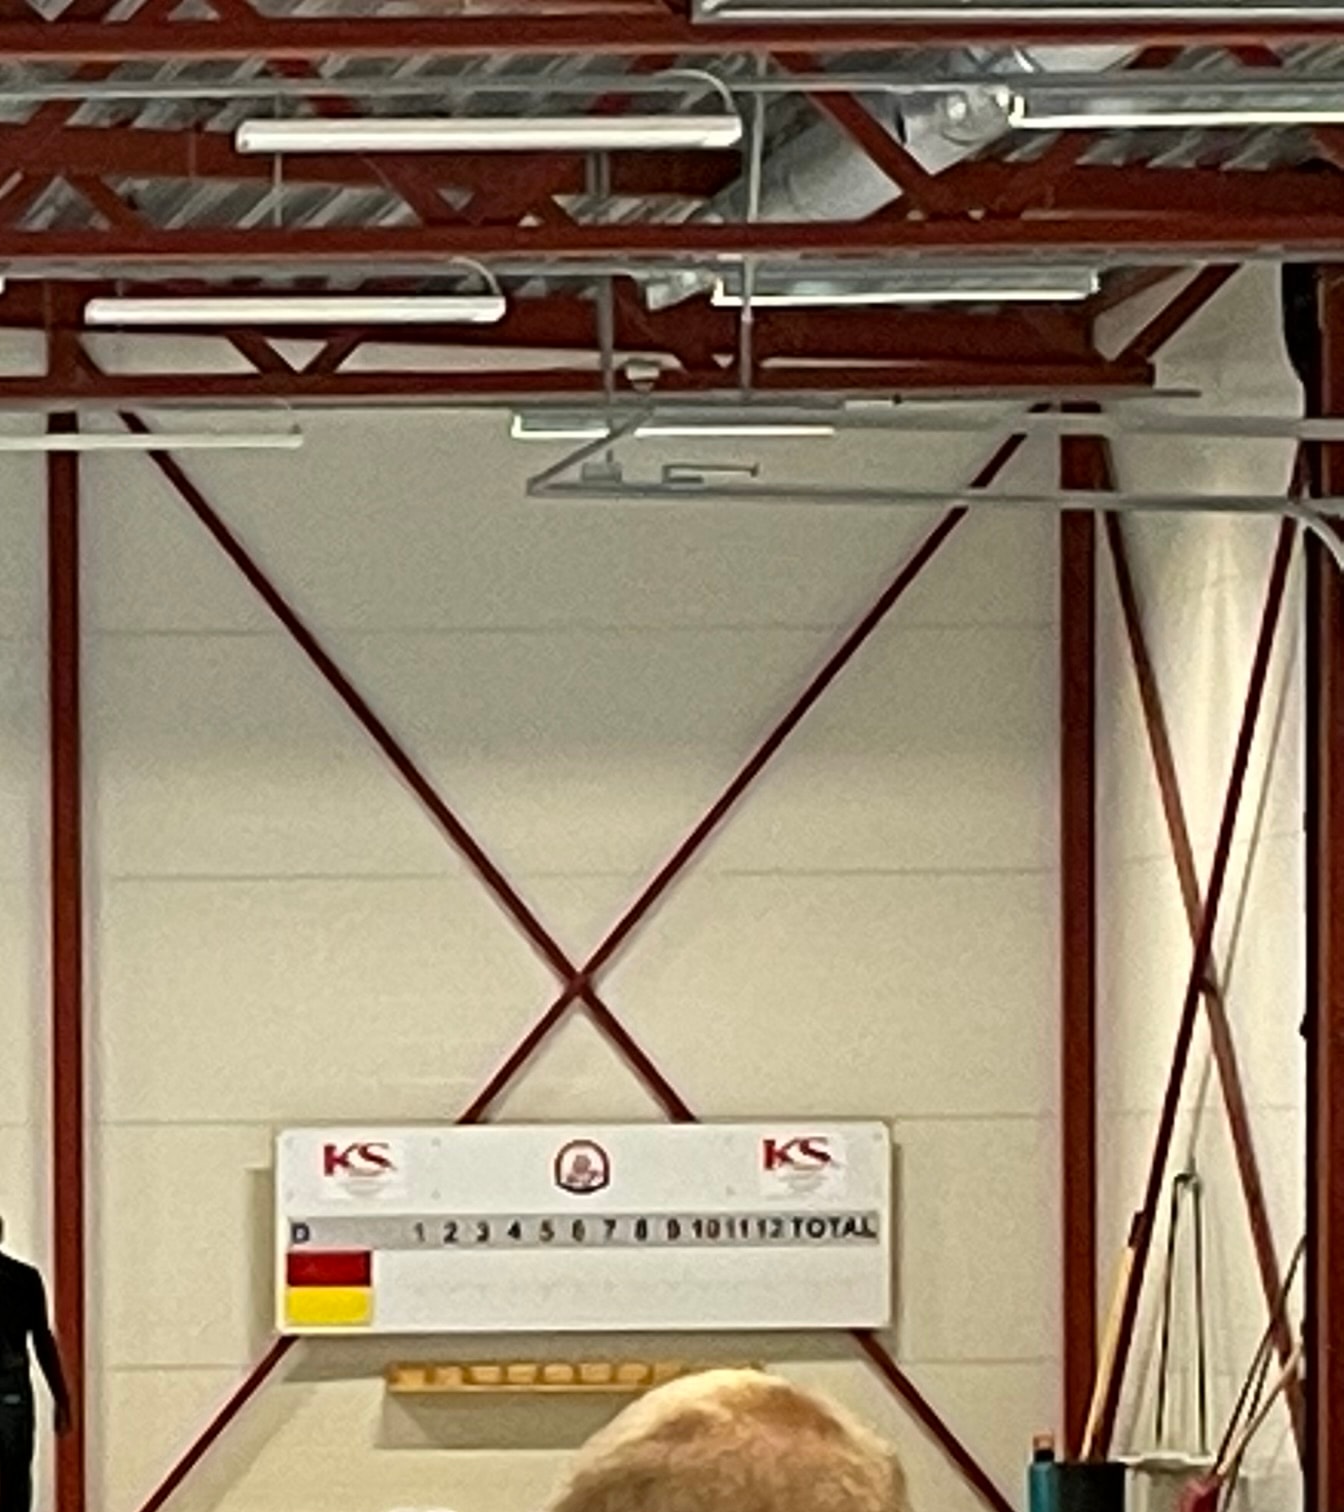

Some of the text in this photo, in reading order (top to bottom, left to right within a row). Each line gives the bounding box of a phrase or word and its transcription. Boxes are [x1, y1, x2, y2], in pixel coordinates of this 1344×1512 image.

[323, 1142, 393, 1177] KS
[763, 1136, 833, 1171] KS
[291, 1221, 310, 1244] D
[414, 1222, 425, 1243] 1
[443, 1221, 458, 1244] 2
[477, 1221, 491, 1243] 3
[507, 1220, 522, 1241] 4
[539, 1219, 555, 1243] 5
[603, 1218, 617, 1242] 7
[692, 1218, 720, 1240] 10
[726, 1218, 749, 1240] 11
[756, 1217, 783, 1240] 12
[790, 1216, 878, 1239] TOTAL
